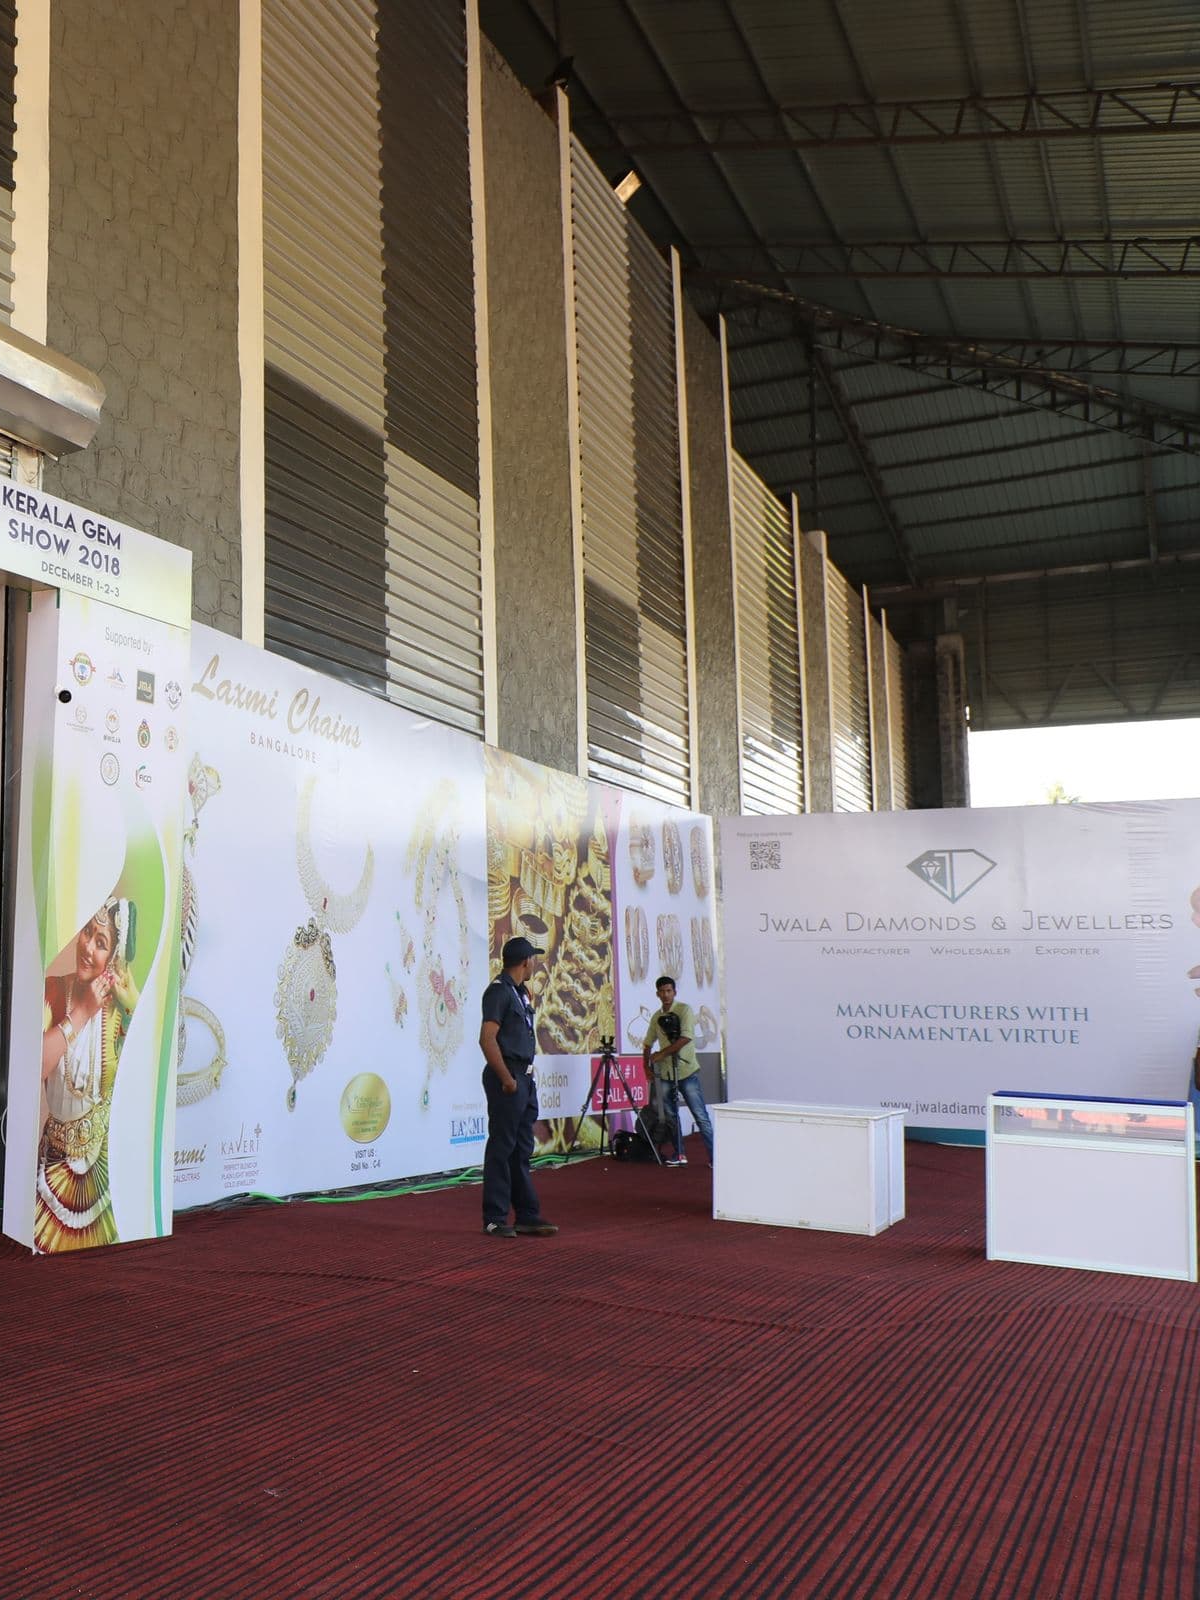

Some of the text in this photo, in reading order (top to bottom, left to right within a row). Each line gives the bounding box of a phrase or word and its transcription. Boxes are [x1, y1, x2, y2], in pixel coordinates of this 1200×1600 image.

[2, 488, 77, 534] KERALA
[82, 519, 122, 550] GEM
[8, 518, 70, 557] SHOW
[79, 545, 121, 577] 2018
[41, 561, 120, 598] DECEMBER 1-2-3
[104, 626, 141, 651] Supported
[191, 654, 362, 749] Laxmi Chains
[250, 732, 318, 764] BANGALORE
[759, 910, 1174, 932] JWALA DIAMONDS & JEWELLERS
[836, 1003, 1089, 1022] MANUFACTURERS WITH
[846, 1025, 1080, 1045] ORNAMENTAL VIRTUE
[541, 1071, 569, 1088] Action
[541, 1092, 561, 1109] Gold
[596, 1087, 622, 1104] SALL
[174, 1144, 207, 1166] axmi
